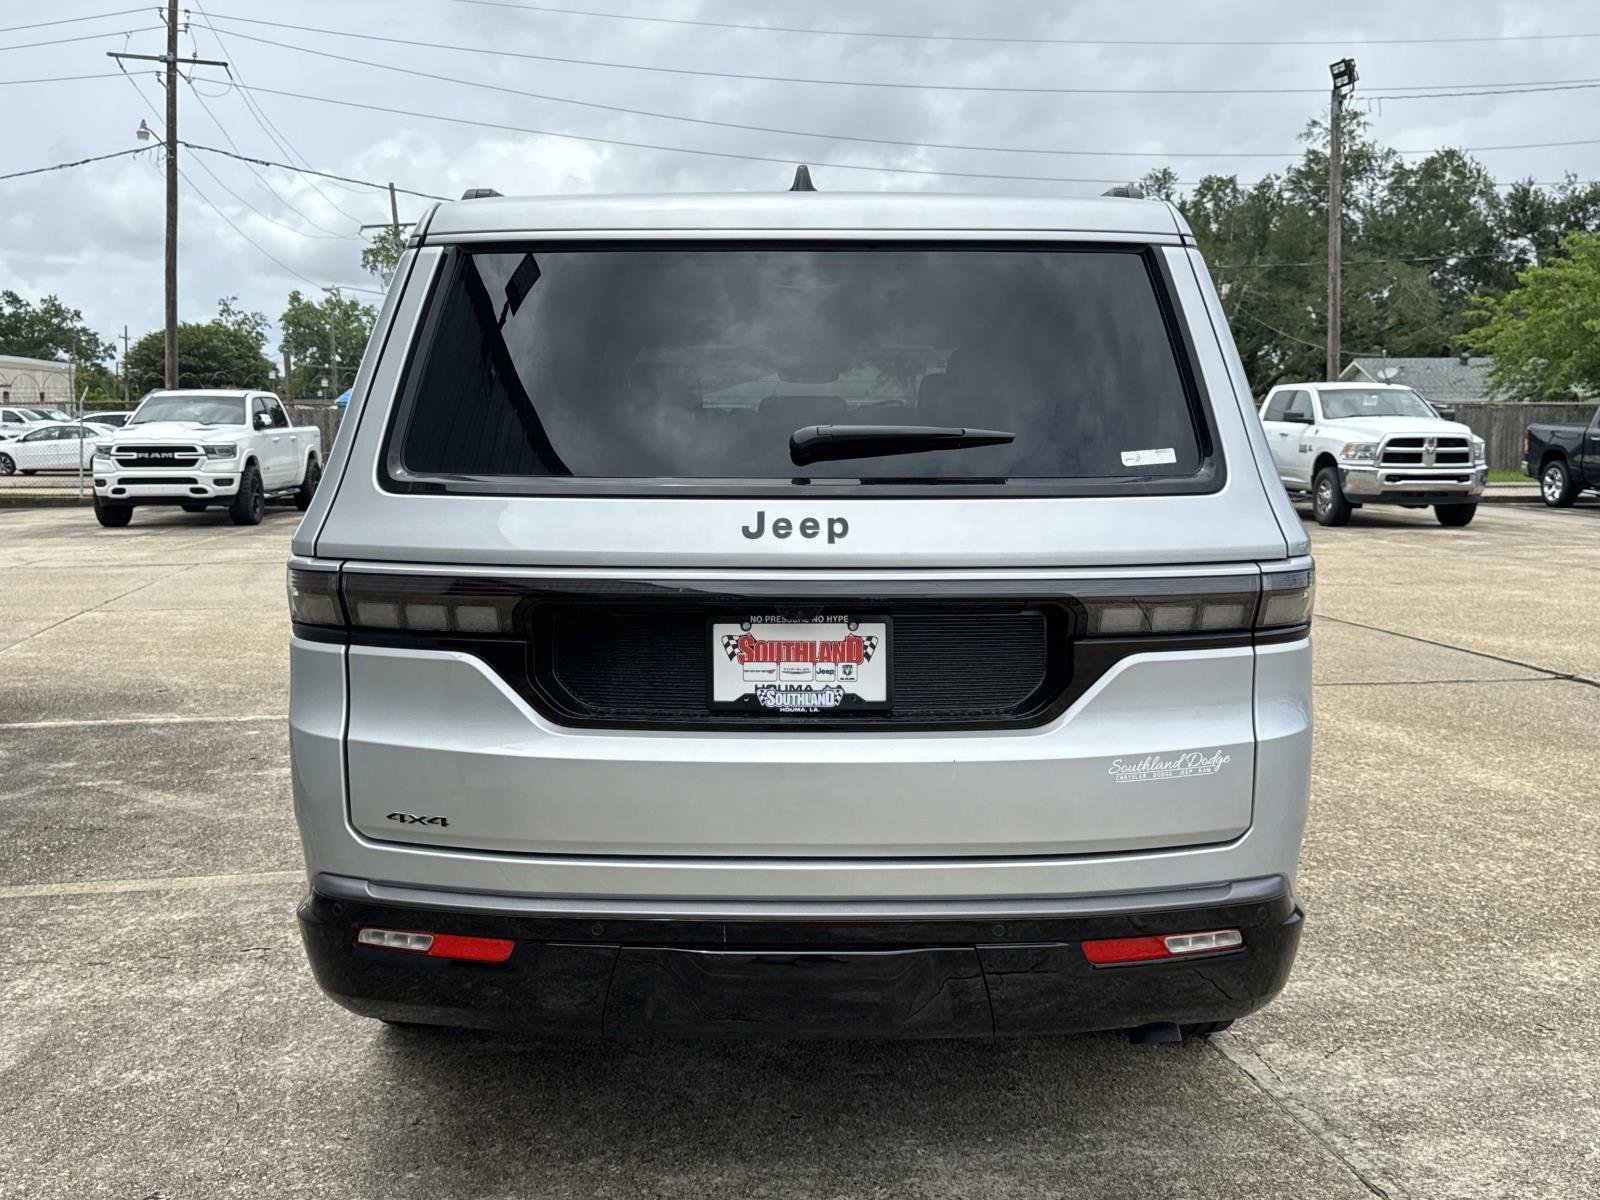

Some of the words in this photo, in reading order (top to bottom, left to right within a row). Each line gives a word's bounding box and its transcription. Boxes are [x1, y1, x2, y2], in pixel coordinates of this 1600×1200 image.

[741, 510, 849, 545] Jeep
[750, 615, 763, 623] NO
[765, 615, 810, 623] PRES
[812, 615, 824, 623] NO
[826, 615, 849, 623] HYPE
[738, 634, 863, 664] SOUTHLAND
[816, 667, 835, 675] Jeep
[766, 690, 835, 707] SOUTHLAND
[1108, 753, 1188, 775] Southland
[1185, 749, 1231, 772] Dodge
